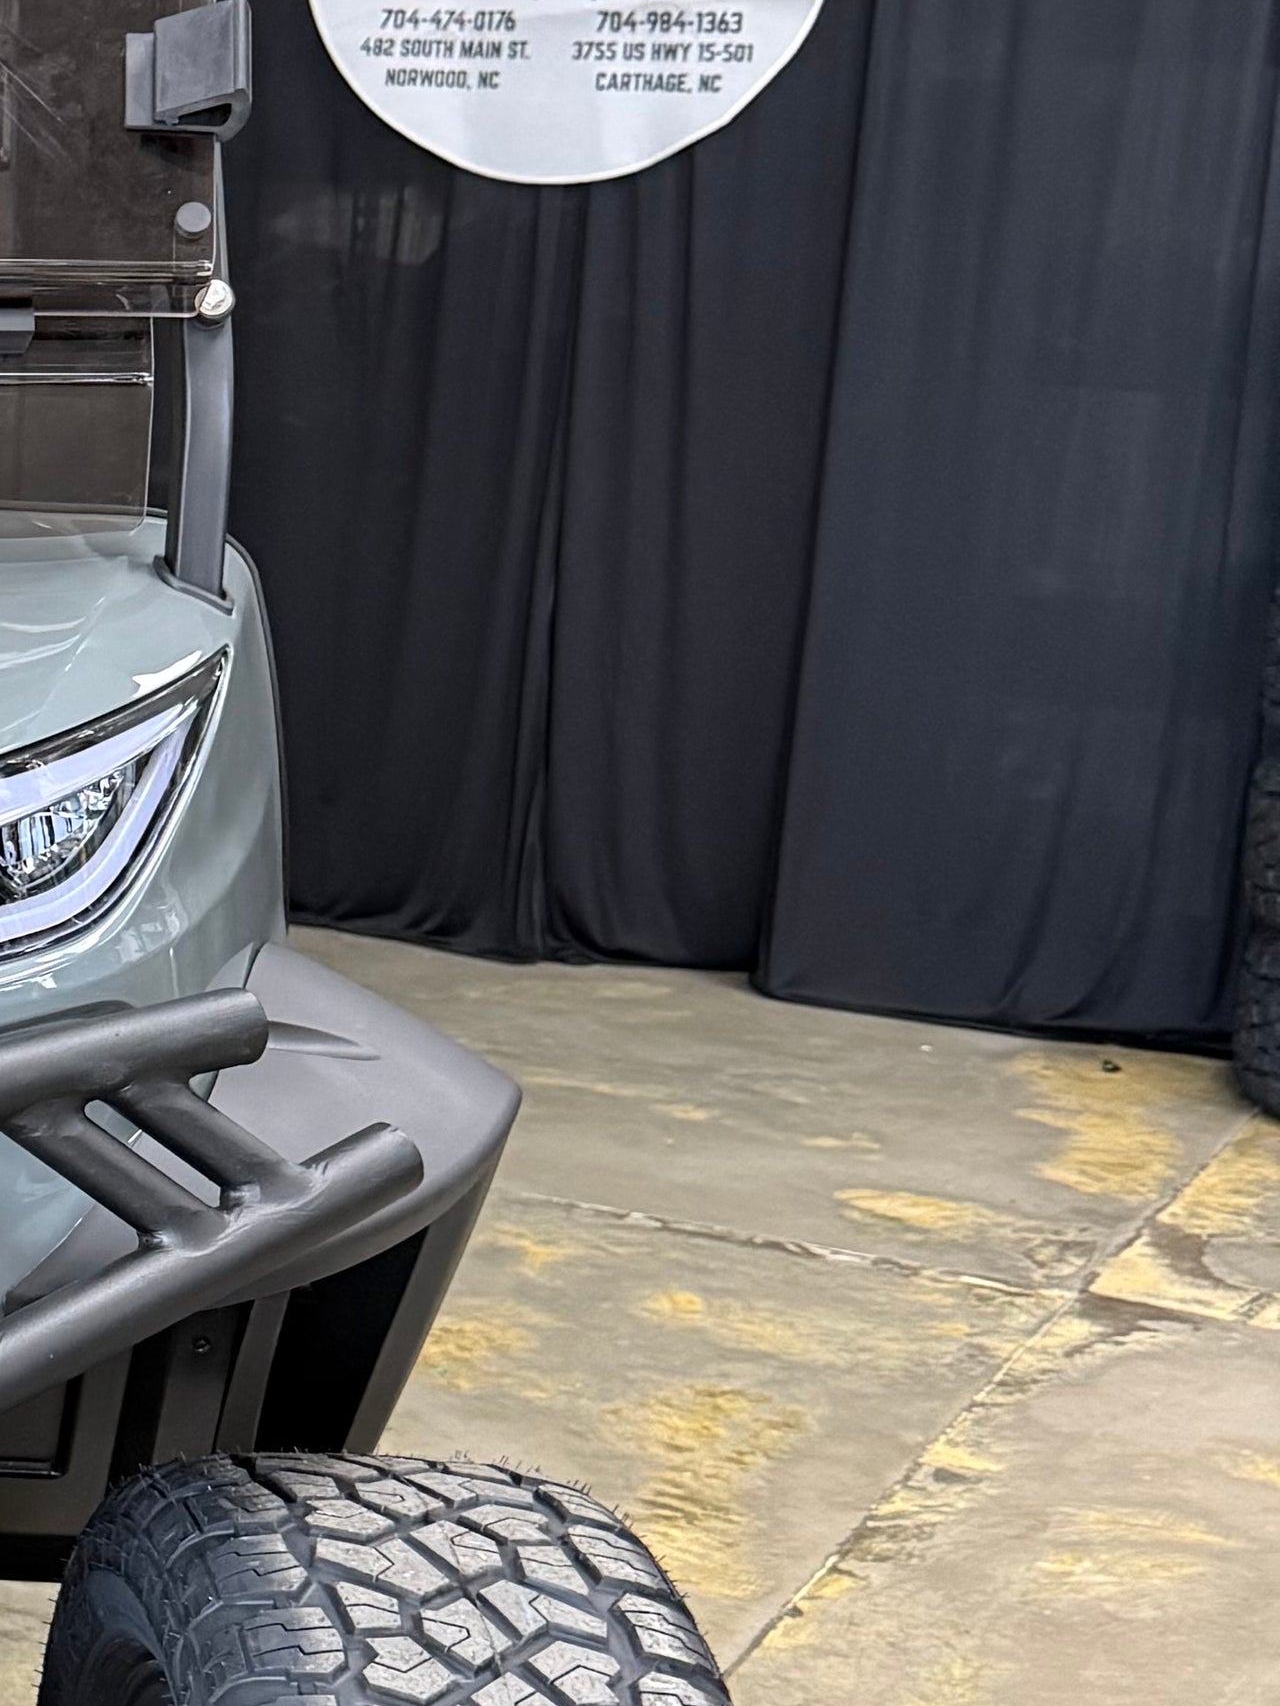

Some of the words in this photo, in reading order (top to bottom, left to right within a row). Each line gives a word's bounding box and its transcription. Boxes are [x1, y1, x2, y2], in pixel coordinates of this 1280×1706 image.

[380, 8, 517, 32] 704-474-0176
[596, 10, 744, 34] 704-984-1363
[360, 37, 394, 57] 482
[399, 38, 454, 59] SOUTH
[459, 40, 502, 59] MAIN
[506, 40, 531, 60] ST.
[572, 41, 617, 61] 3755
[622, 42, 646, 61] US
[650, 43, 692, 62] HWY
[697, 43, 754, 62] 15-501
[384, 68, 471, 91] NORWOOD,
[477, 70, 500, 90] NC
[595, 72, 692, 93] CARTHAGE,
[697, 74, 723, 93] NC
